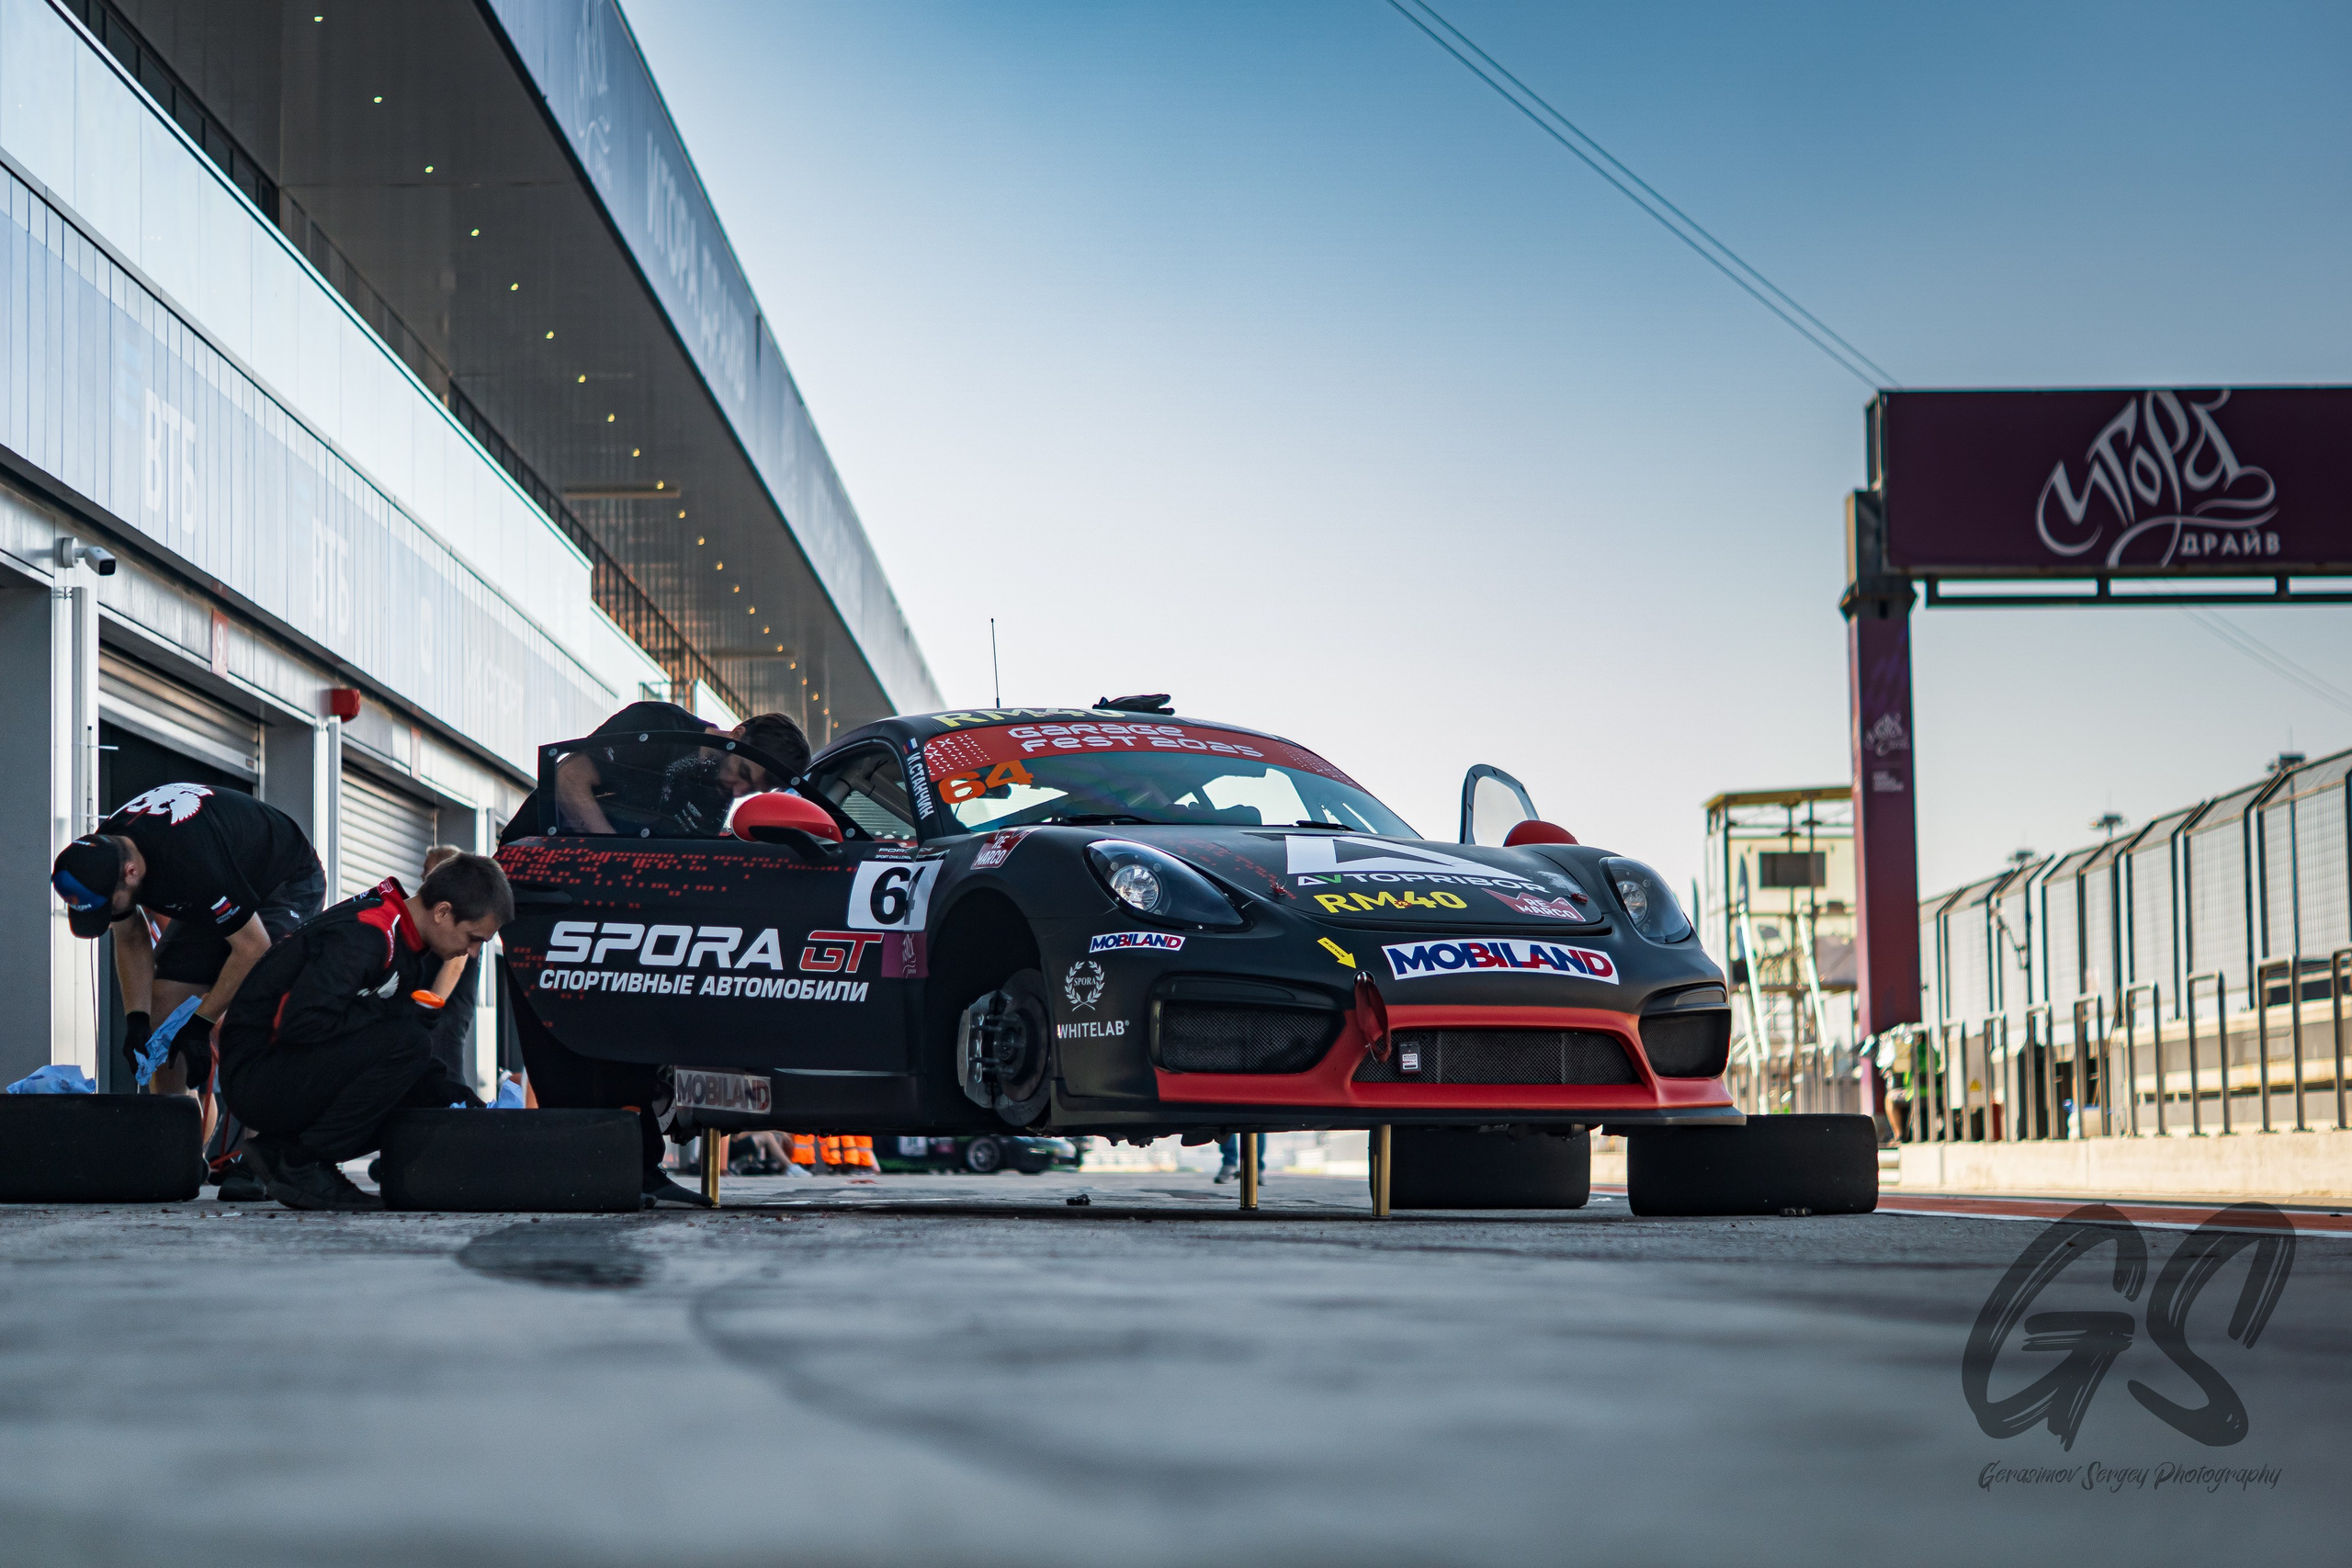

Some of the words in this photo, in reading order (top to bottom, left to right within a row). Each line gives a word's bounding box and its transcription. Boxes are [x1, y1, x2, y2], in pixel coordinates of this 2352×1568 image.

[145, 387, 196, 535] ВТБ
[2180, 529, 2280, 557] ДРАЙВ
[313, 515, 349, 637] ВТБ
[1152, 739, 1264, 758] 2025
[938, 760, 1035, 805] 64
[991, 835, 1010, 850] RE
[974, 849, 1007, 865] MARCO
[1314, 890, 1468, 913] RM40
[1514, 904, 1578, 919] MARCO
[1522, 897, 1550, 908] RE
[546, 921, 784, 970] SPORA
[799, 930, 885, 974] GT
[1091, 933, 1182, 951] MOBILAND
[1386, 942, 1613, 976] MOBILAND
[539, 969, 693, 995] СПОРТИВНЫЕ
[699, 976, 869, 1002] АВТОМОБИЛИ
[1073, 976, 1096, 987] SPORA
[677, 1073, 770, 1111] MOBILAND
